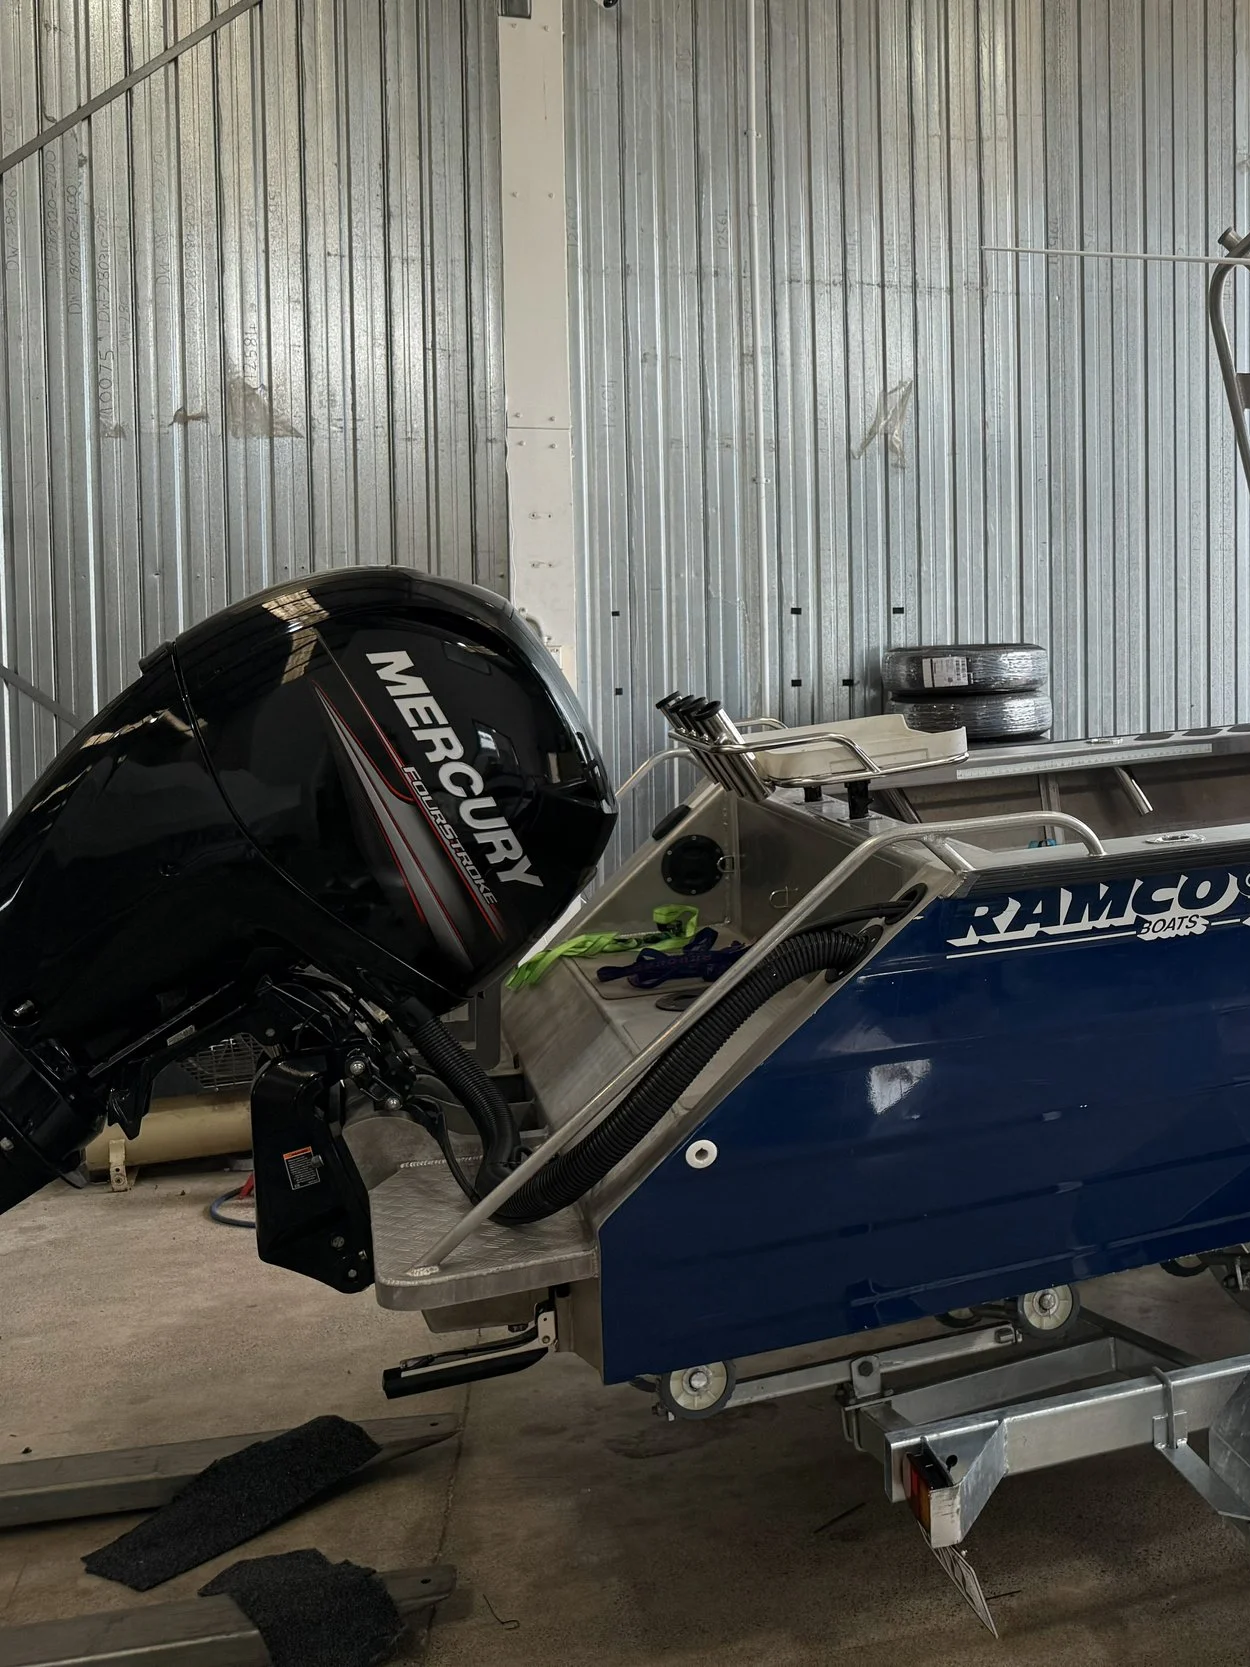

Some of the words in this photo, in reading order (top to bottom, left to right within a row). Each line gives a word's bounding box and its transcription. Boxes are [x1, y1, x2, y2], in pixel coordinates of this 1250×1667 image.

[365, 650, 544, 888] MERCURY
[402, 765, 498, 905] FOURSTROKE
[946, 870, 1241, 947] RAMCO
[1139, 913, 1206, 938] BOATS
